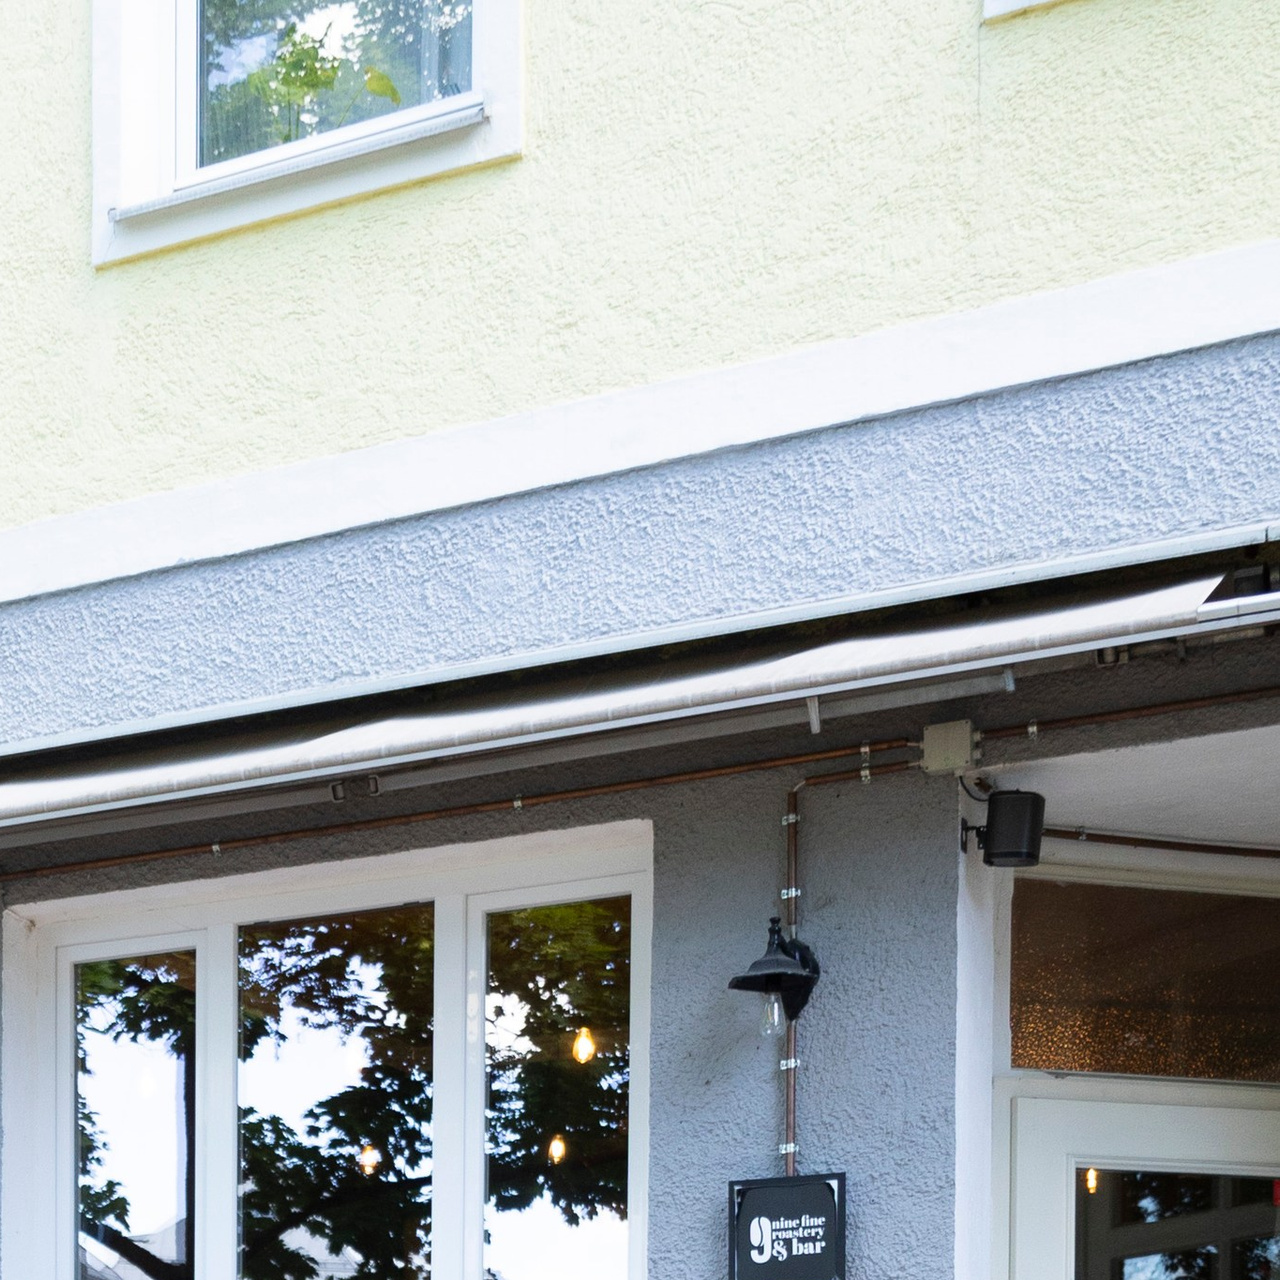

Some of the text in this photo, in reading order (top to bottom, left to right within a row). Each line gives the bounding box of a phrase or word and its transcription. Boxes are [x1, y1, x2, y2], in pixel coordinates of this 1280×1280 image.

[771, 1214, 826, 1230] nine fine
[771, 1226, 825, 1240] roastery
[771, 1238, 826, 1262] & bar
